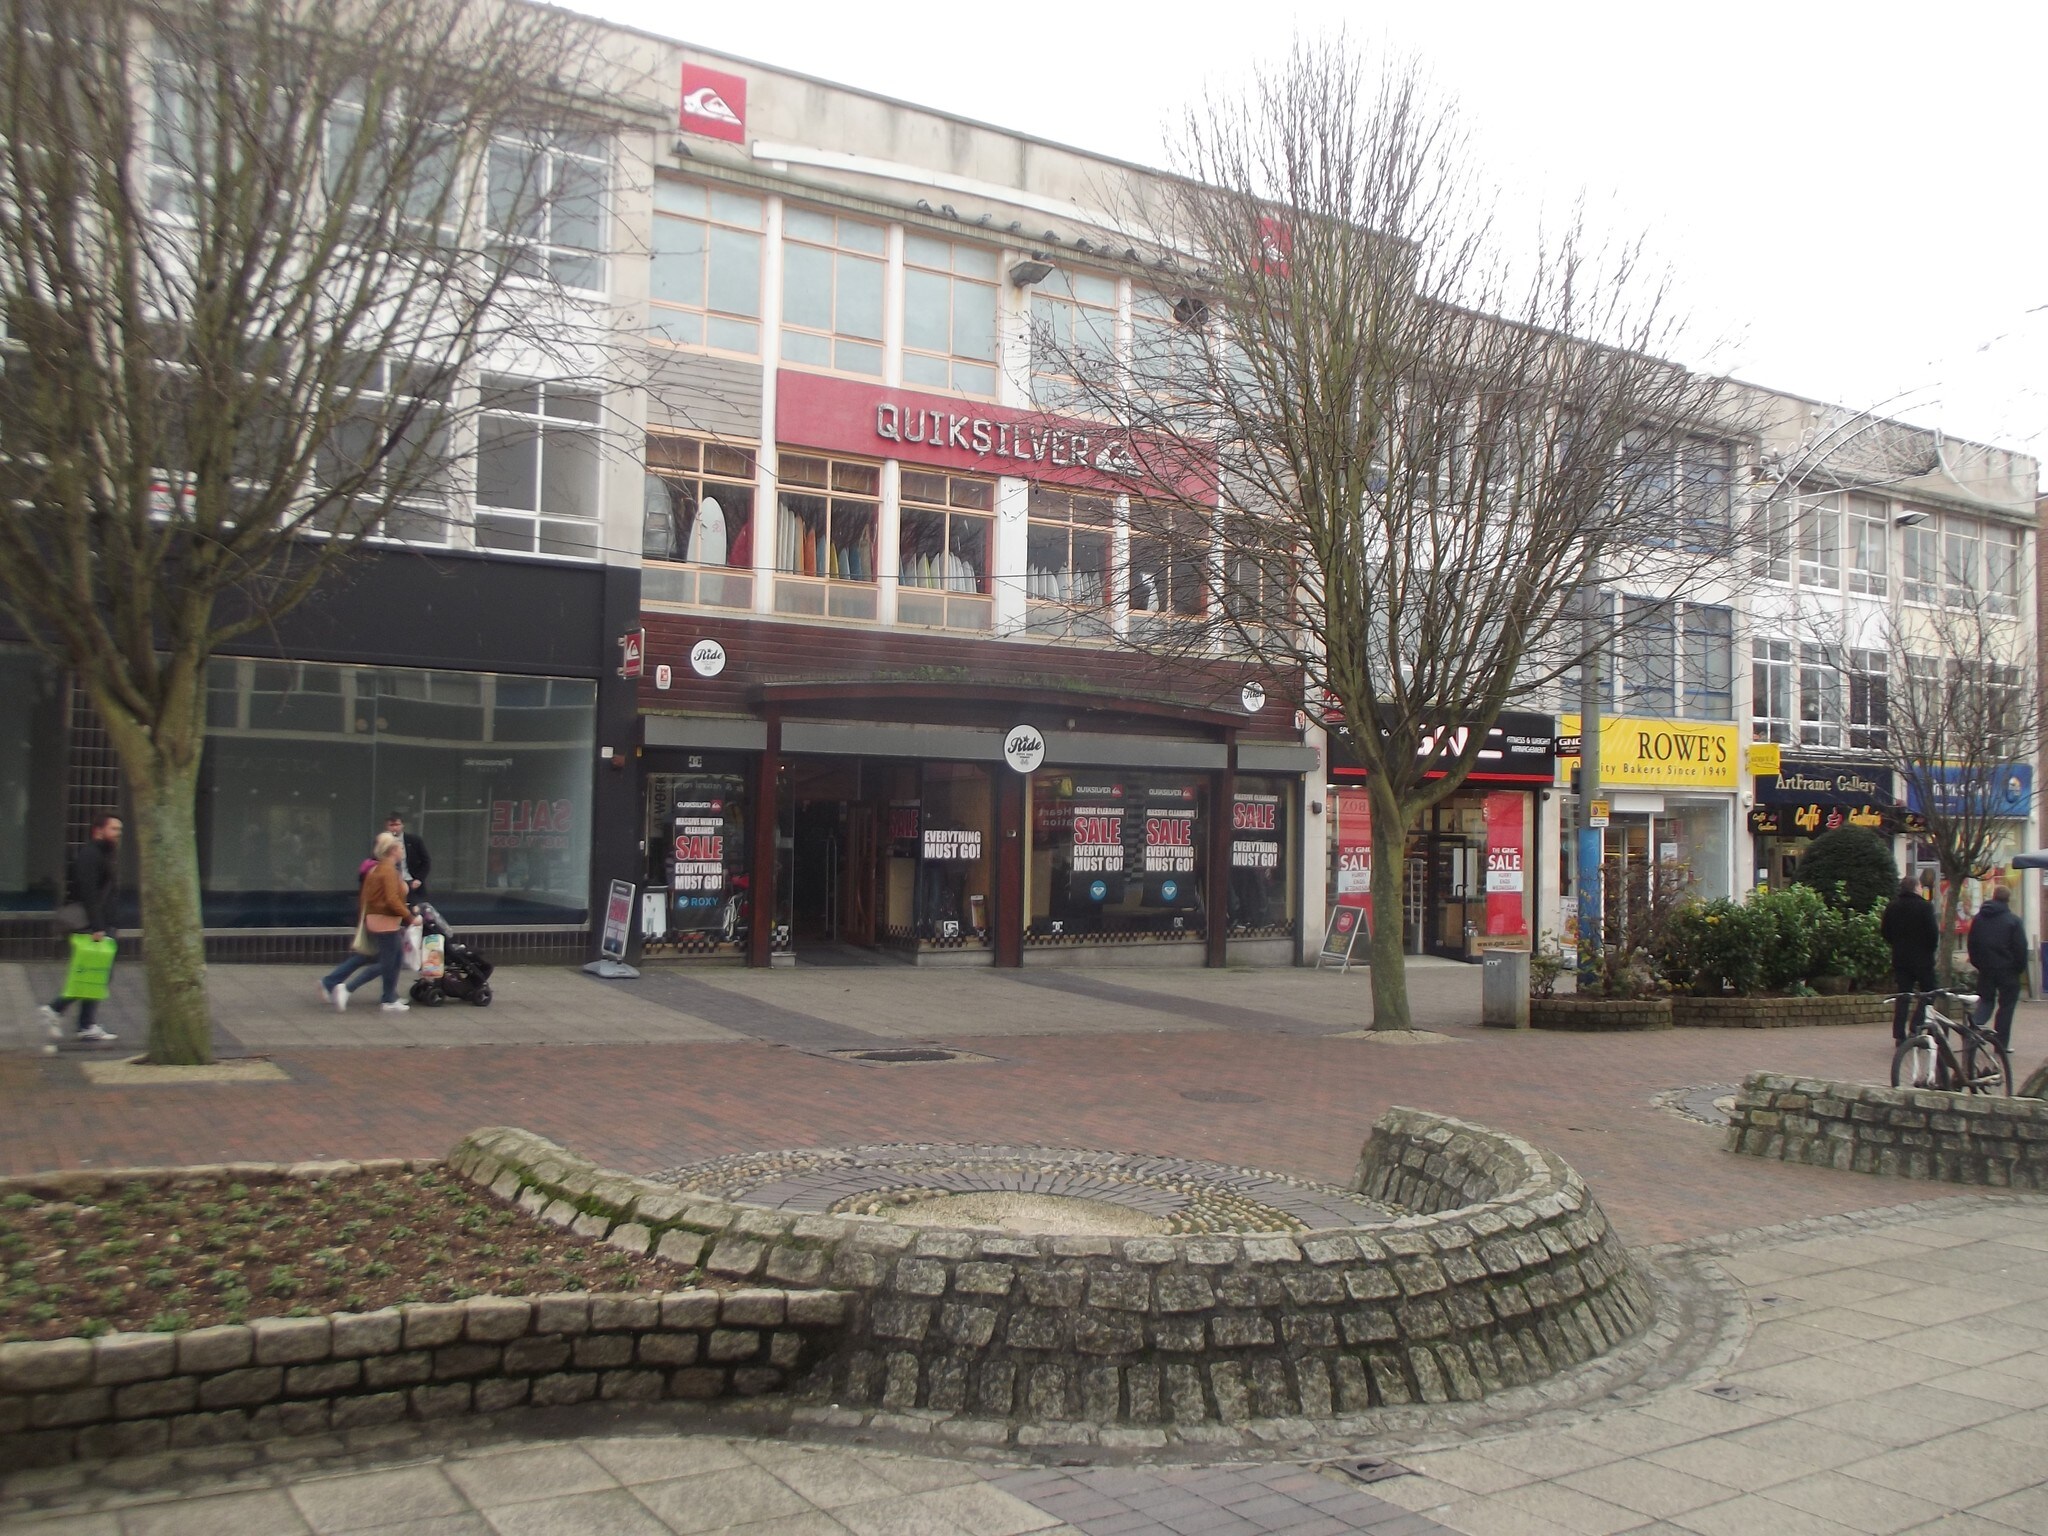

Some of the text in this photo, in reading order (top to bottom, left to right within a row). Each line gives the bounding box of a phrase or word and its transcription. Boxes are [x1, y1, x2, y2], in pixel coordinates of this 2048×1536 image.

[877, 403, 1088, 466] QUIKSILVER
[694, 648, 722, 661] Ride
[1007, 736, 1042, 754] Ride
[1637, 732, 1727, 763] ROWE'S
[1623, 763, 1661, 774] Bakers
[1667, 764, 1696, 775] Since
[1703, 766, 1727, 776] 1949
[1775, 772, 1876, 795] ArtFrame Gallery
[1149, 788, 1181, 796] QUIKSILVER
[1233, 802, 1275, 829] SALE
[924, 830, 980, 843] EVERYTHING
[1074, 817, 1121, 844] SALE
[1146, 819, 1191, 845] SALE
[676, 836, 723, 860] SALE
[924, 844, 980, 858] MUST GO!
[1074, 846, 1124, 856] EVERYTHING
[1146, 846, 1194, 856] EVERYTHING
[1233, 841, 1277, 852] EVERYTHING
[1073, 857, 1123, 871] MUST GO!
[1146, 858, 1193, 871] MUST GO!
[1233, 853, 1277, 866] MUST GO!
[1488, 854, 1520, 870] SALE
[675, 863, 721, 873] EVERYTHING
[675, 876, 722, 889] MUST GO!
[691, 897, 718, 906] ROXY
